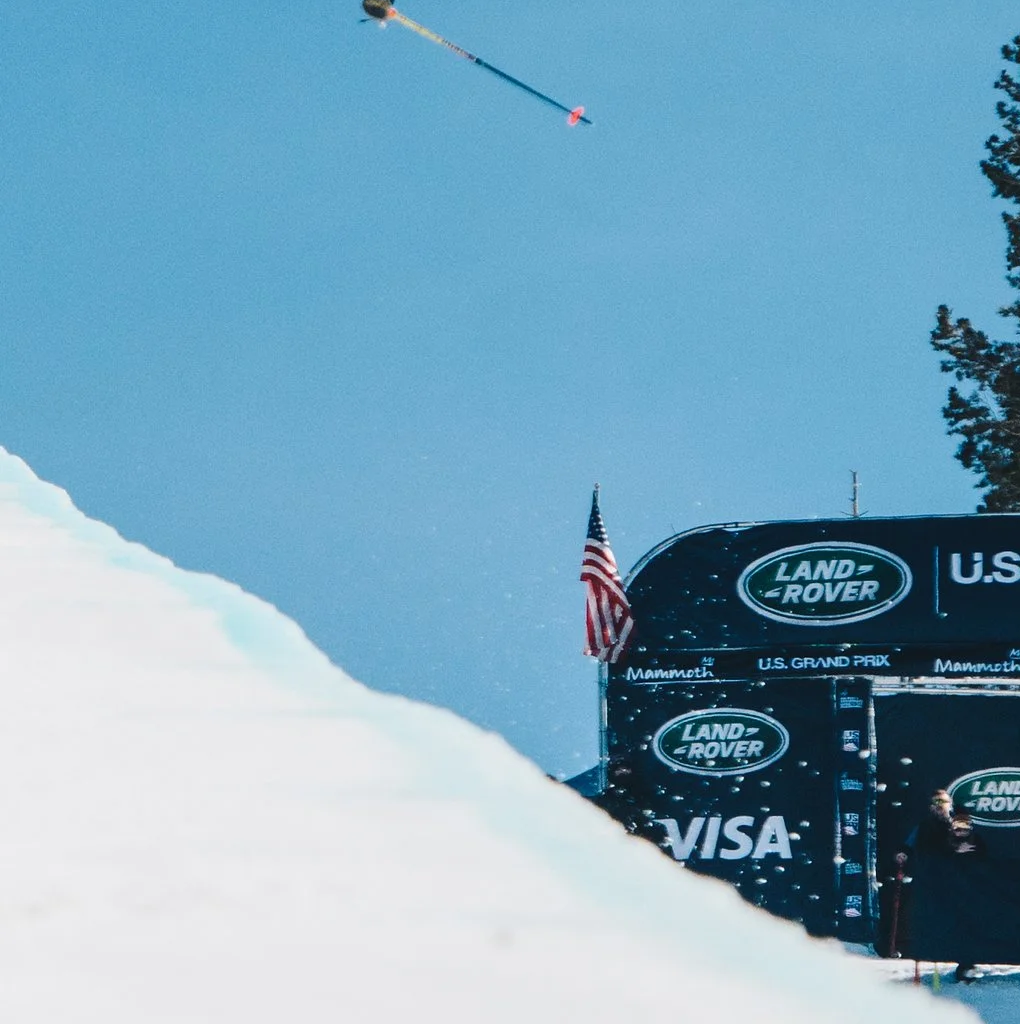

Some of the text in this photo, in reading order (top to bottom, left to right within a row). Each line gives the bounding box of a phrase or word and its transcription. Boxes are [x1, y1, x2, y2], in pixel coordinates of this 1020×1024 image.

[775, 559, 856, 581] LAND
[782, 581, 880, 604] ROVER
[758, 655, 891, 670] U.S. GRAND PRIX
[625, 666, 714, 681] Mammoth
[681, 723, 745, 741] LAND
[687, 740, 764, 759] ROVER
[652, 816, 793, 860] VISA
